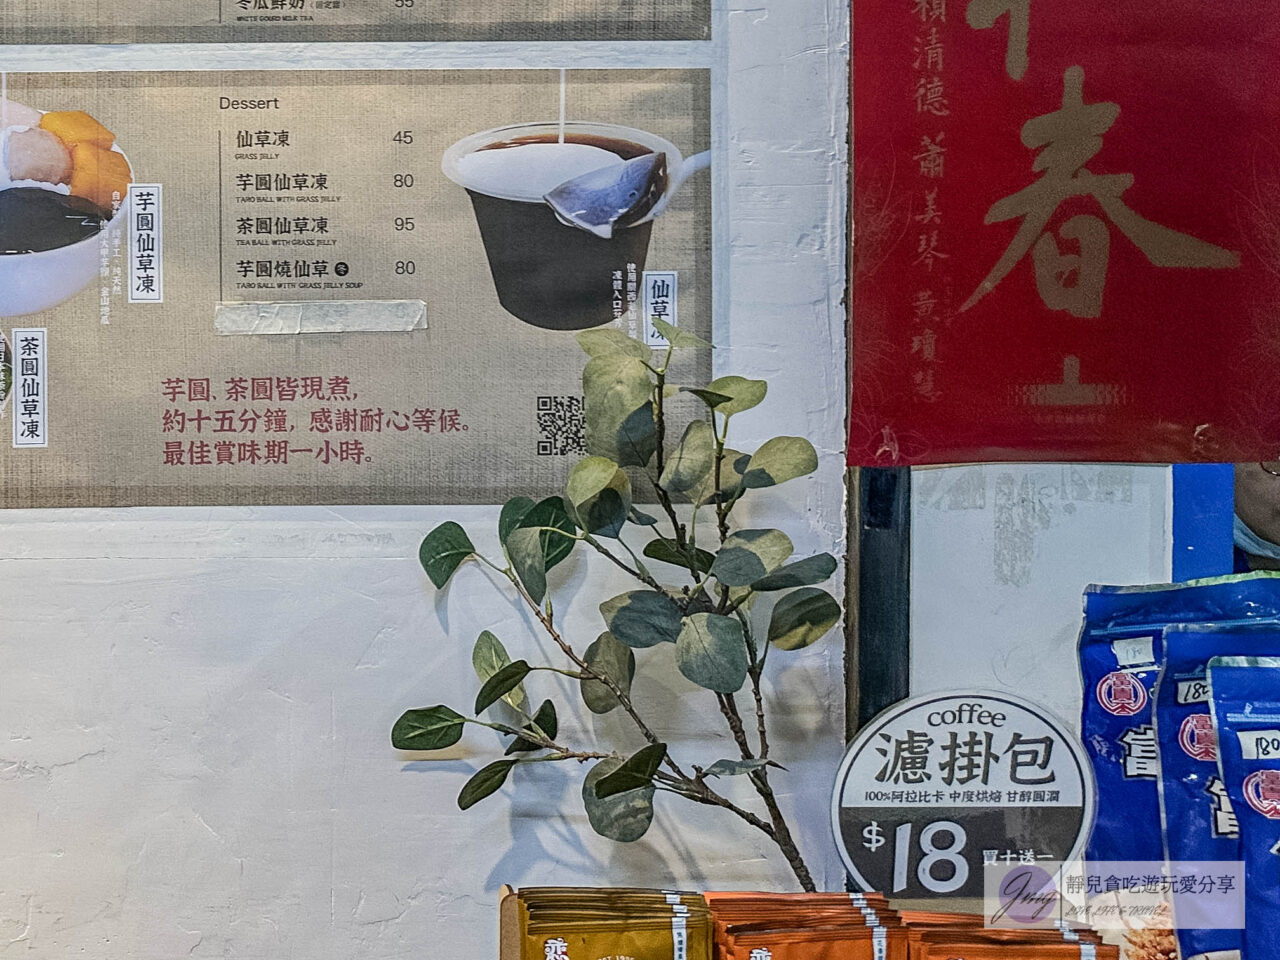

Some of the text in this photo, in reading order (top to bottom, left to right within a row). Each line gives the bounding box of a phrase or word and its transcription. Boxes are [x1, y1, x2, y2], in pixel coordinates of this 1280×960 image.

[220, 97, 279, 110] Dessert
[237, 130, 413, 148] 仙草凍 45
[236, 173, 414, 191] 芋圓仙草凍 80
[912, 131, 950, 272] 蕭美琴
[236, 217, 415, 234] 茶圓仙草凍 95
[135, 192, 155, 293] 芋圓仙草凍
[237, 260, 329, 278] 芋圓燒仙草
[395, 261, 415, 275] 80
[20, 336, 40, 439] 茶圓仙草凍
[162, 439, 374, 466] 最佳賞味期一小時。
[927, 703, 1007, 728] coffee
[875, 729, 1056, 786] 濾掛包
[864, 790, 1060, 803] 100%阿拉比卡 中度烘焙 甘醇圓潤
[862, 820, 970, 893] $18
[982, 849, 1055, 867] 買十送一
